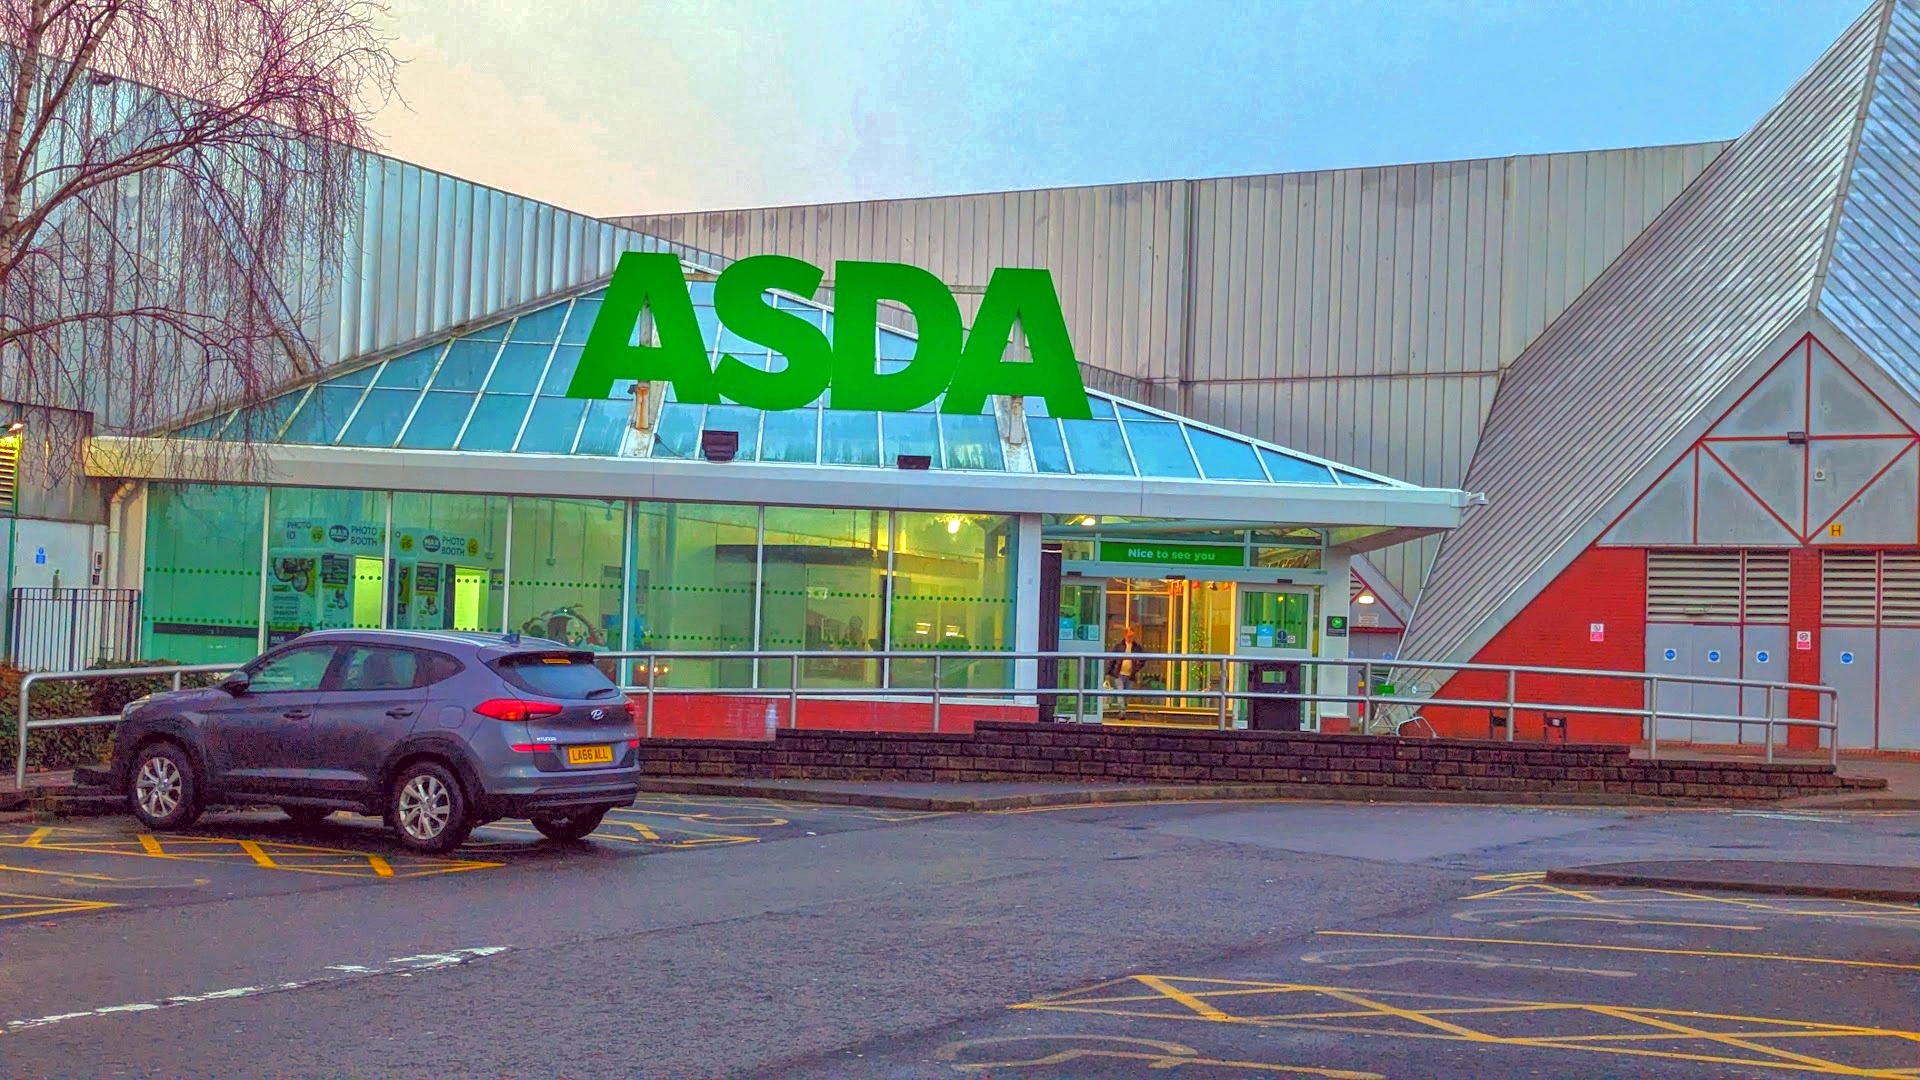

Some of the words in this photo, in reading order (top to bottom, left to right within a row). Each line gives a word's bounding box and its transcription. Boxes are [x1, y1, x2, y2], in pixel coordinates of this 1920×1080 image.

[566, 251, 1093, 419] ASDA
[287, 521, 312, 529] PHOTO
[1831, 524, 1841, 536] H
[286, 531, 296, 540] ID
[351, 526, 378, 536] PHOTO
[350, 537, 378, 546] BOOTH
[442, 536, 465, 546] PHOTO
[441, 546, 465, 556] BOOTH
[1128, 548, 1154, 559] Nice
[1157, 550, 1169, 559] to
[1171, 551, 1191, 560] see
[1194, 552, 1216, 561] you
[572, 748, 593, 761] LA66
[594, 748, 609, 760] ALL
